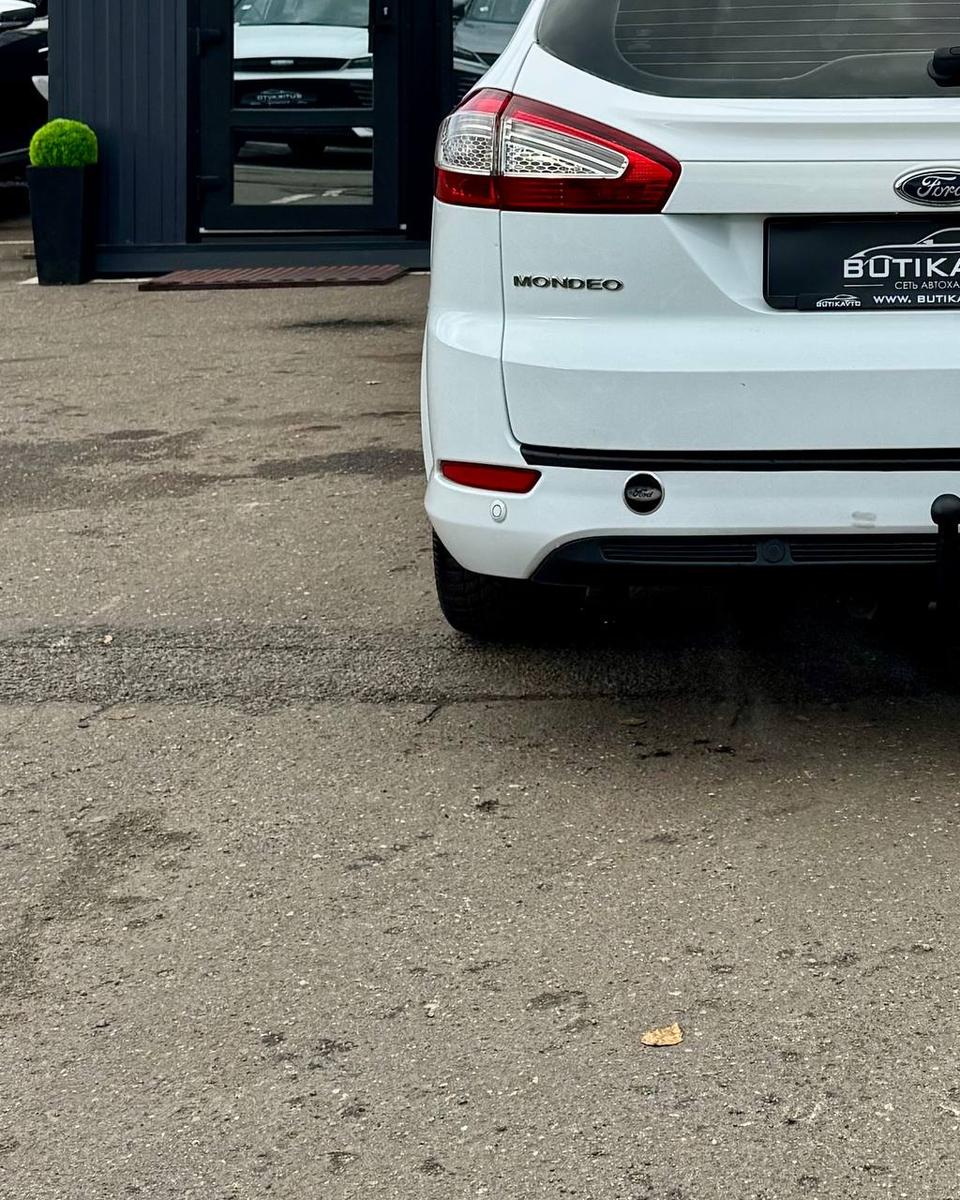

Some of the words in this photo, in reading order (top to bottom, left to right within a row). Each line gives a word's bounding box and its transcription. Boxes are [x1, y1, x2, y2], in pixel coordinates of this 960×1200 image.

[513, 275, 624, 291] MONDEO
[894, 281, 918, 290] СЕТЬ
[873, 295, 912, 304] WWW.
